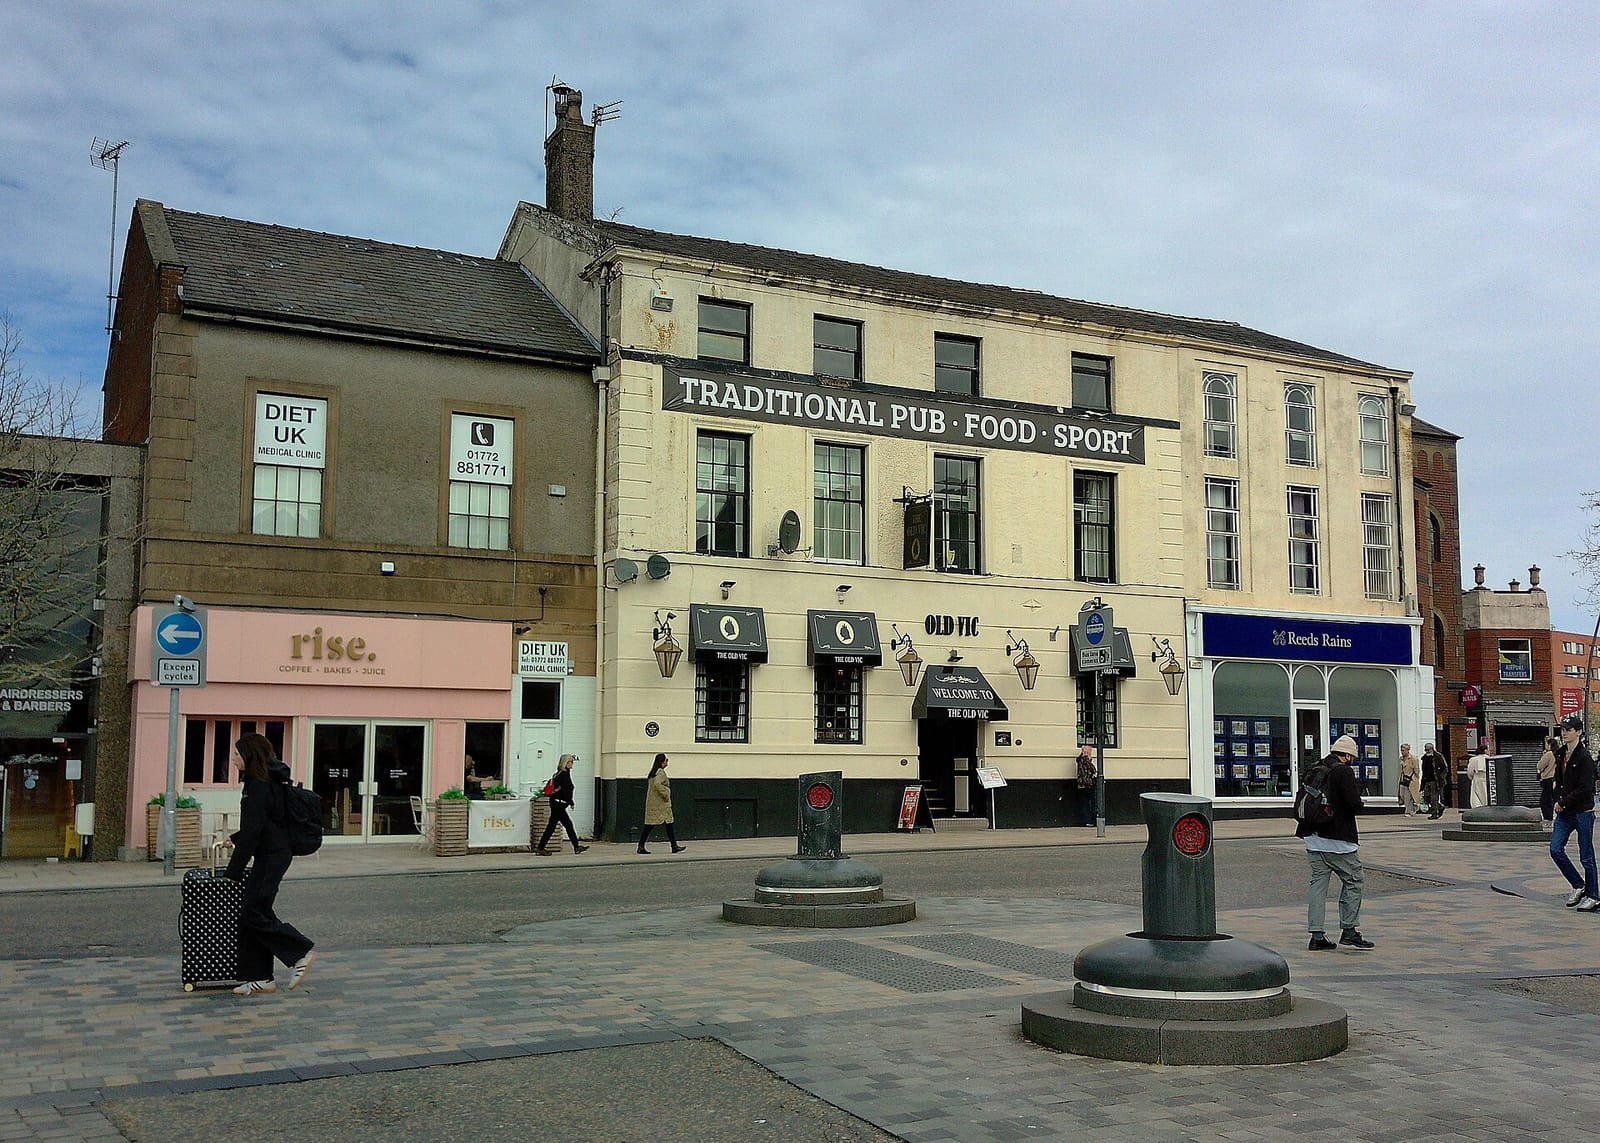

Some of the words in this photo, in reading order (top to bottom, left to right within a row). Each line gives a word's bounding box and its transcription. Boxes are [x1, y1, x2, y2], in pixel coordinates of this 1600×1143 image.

[266, 403, 317, 423] DIET
[679, 376, 883, 427] TRADITIONAL
[890, 404, 946, 433] PUB
[964, 413, 1036, 444] FOOD
[1054, 424, 1133, 454] SPORT
[275, 426, 306, 444] UK
[258, 447, 293, 457] MEDICAL
[295, 450, 321, 459] CLINIC
[467, 450, 499, 461] 01772
[457, 462, 506, 477] 881771
[925, 614, 954, 635] OLD
[957, 616, 979, 636] VIC
[291, 627, 377, 661] rise.
[1288, 631, 1319, 646] Reeds
[1322, 633, 1352, 648] Rains
[522, 643, 546, 656] DIET
[550, 644, 565, 656] UK
[717, 652, 727, 660] THE
[727, 652, 739, 660] OLD
[739, 653, 748, 661] VIC
[163, 663, 195, 672] Except
[279, 665, 312, 673] COFFEE
[164, 673, 193, 681] cycles
[0, 689, 83, 701] AIRDRESSERS
[932, 687, 980, 699] WELCOME
[980, 690, 994, 700] TO
[2, 701, 11, 711] &
[14, 701, 72, 712] BARBERS
[947, 708, 962, 718] THE
[962, 708, 976, 718] OLD
[977, 709, 989, 719] VIC
[483, 815, 515, 828] rise.
